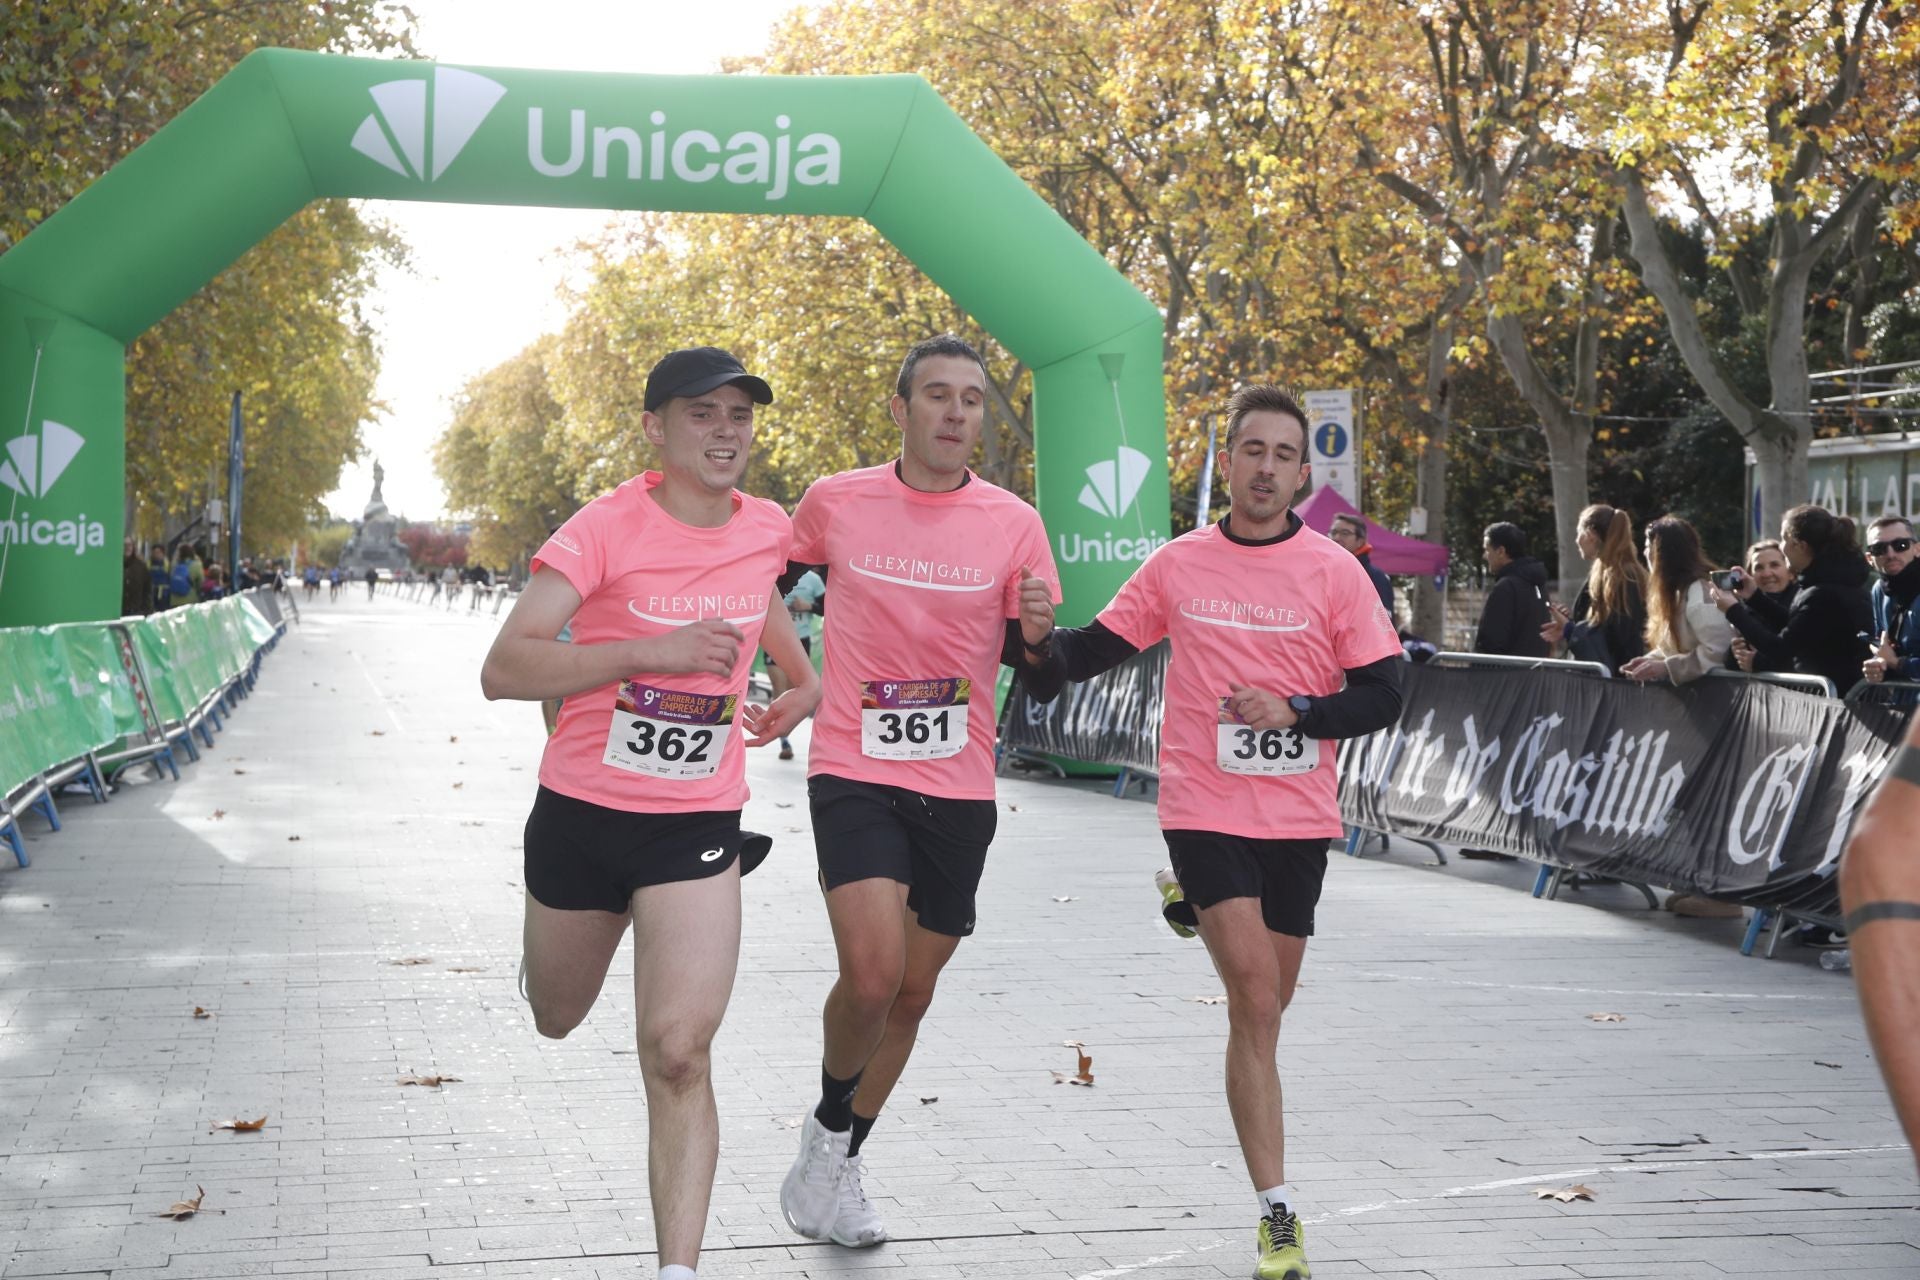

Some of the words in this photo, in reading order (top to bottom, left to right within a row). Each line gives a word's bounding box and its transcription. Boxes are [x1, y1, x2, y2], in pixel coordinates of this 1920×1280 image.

[528, 107, 841, 200] Unicaja
[661, 693, 695, 705] CARRERA
[697, 697, 708, 706] DE
[899, 682, 928, 691] CARRERA
[930, 682, 939, 690] DE
[899, 689, 939, 699] EMPRESAS
[659, 701, 705, 715] EMPRESAS
[627, 720, 713, 763] 362
[878, 710, 948, 744] 361
[1233, 728, 1304, 760] 363
[1443, 714, 1500, 810] de
[1500, 711, 1686, 840] Castilla
